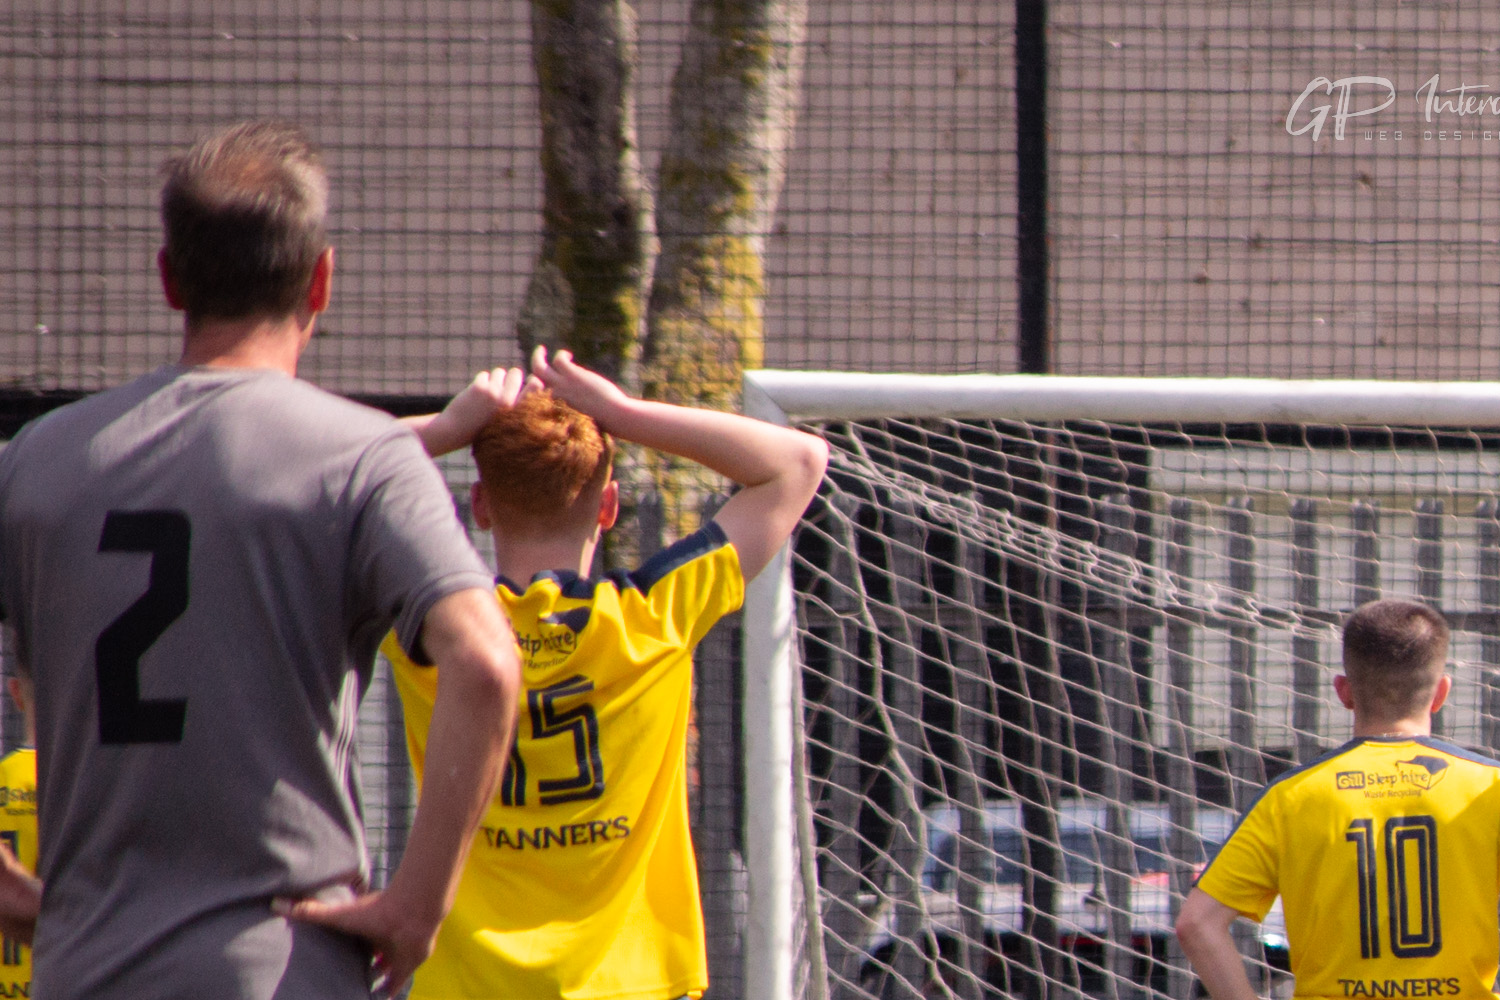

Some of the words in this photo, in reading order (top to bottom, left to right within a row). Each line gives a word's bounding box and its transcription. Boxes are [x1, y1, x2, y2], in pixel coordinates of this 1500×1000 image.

[95, 509, 191, 744] 2
[1337, 772, 1364, 789] Gill
[1400, 770, 1428, 784] hire
[479, 815, 631, 850] TANNER'S
[1345, 815, 1442, 959] 10
[1337, 977, 1461, 998] TANNER'S
